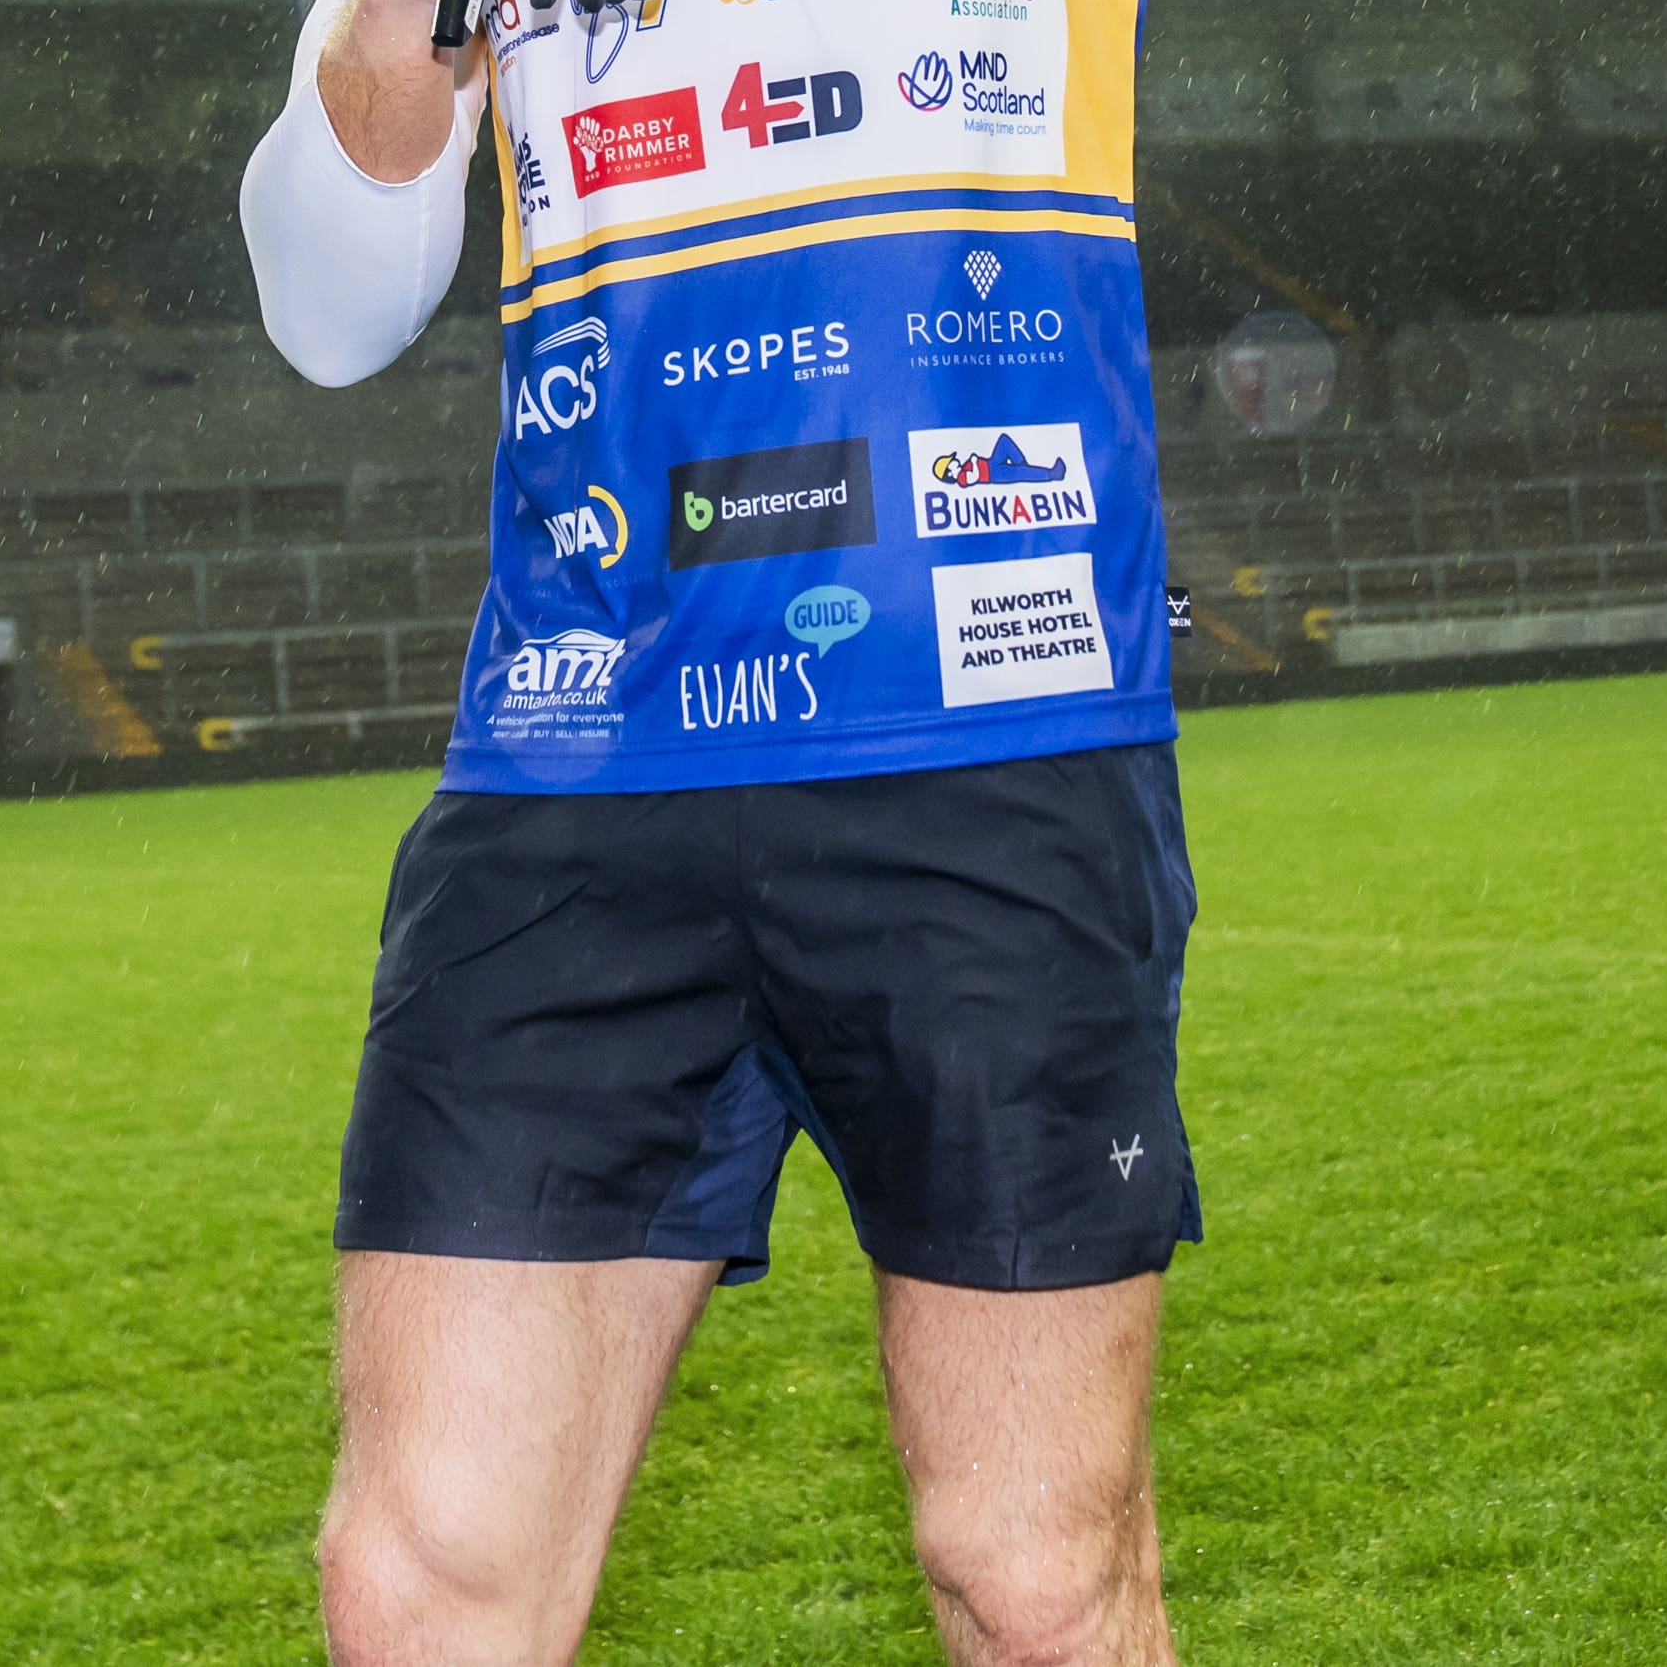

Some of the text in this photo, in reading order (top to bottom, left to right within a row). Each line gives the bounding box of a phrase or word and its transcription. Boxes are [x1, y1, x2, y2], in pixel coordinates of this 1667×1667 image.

[959, 50, 1008, 82] MND
[962, 82, 1045, 116] Scotland
[602, 116, 674, 145] DARBY
[964, 117, 995, 136] Making
[996, 119, 1015, 135] time
[605, 134, 690, 163] RIMMER
[606, 152, 692, 175] FOUNDATION
[906, 309, 1062, 346] ROMERO
[663, 321, 850, 386] SKOPES
[910, 351, 1065, 368] INSURANCE BROKERS
[794, 363, 850, 382] EST. 1948
[515, 355, 597, 441] ACS
[721, 479, 848, 520] bartercard
[924, 490, 1087, 531] BUNKABIN
[793, 599, 860, 630] GUIDE
[970, 587, 1073, 616] KILWORTH
[959, 611, 1093, 643] HOUSE HOTEL
[507, 638, 627, 692] amt
[961, 637, 1097, 669] AND THEATRE
[503, 687, 607, 710] amtauto.co.uk
[680, 651, 818, 730] EUAN'S
[486, 715, 495, 725] A
[556, 711, 570, 723] for
[572, 712, 625, 726] everyone
